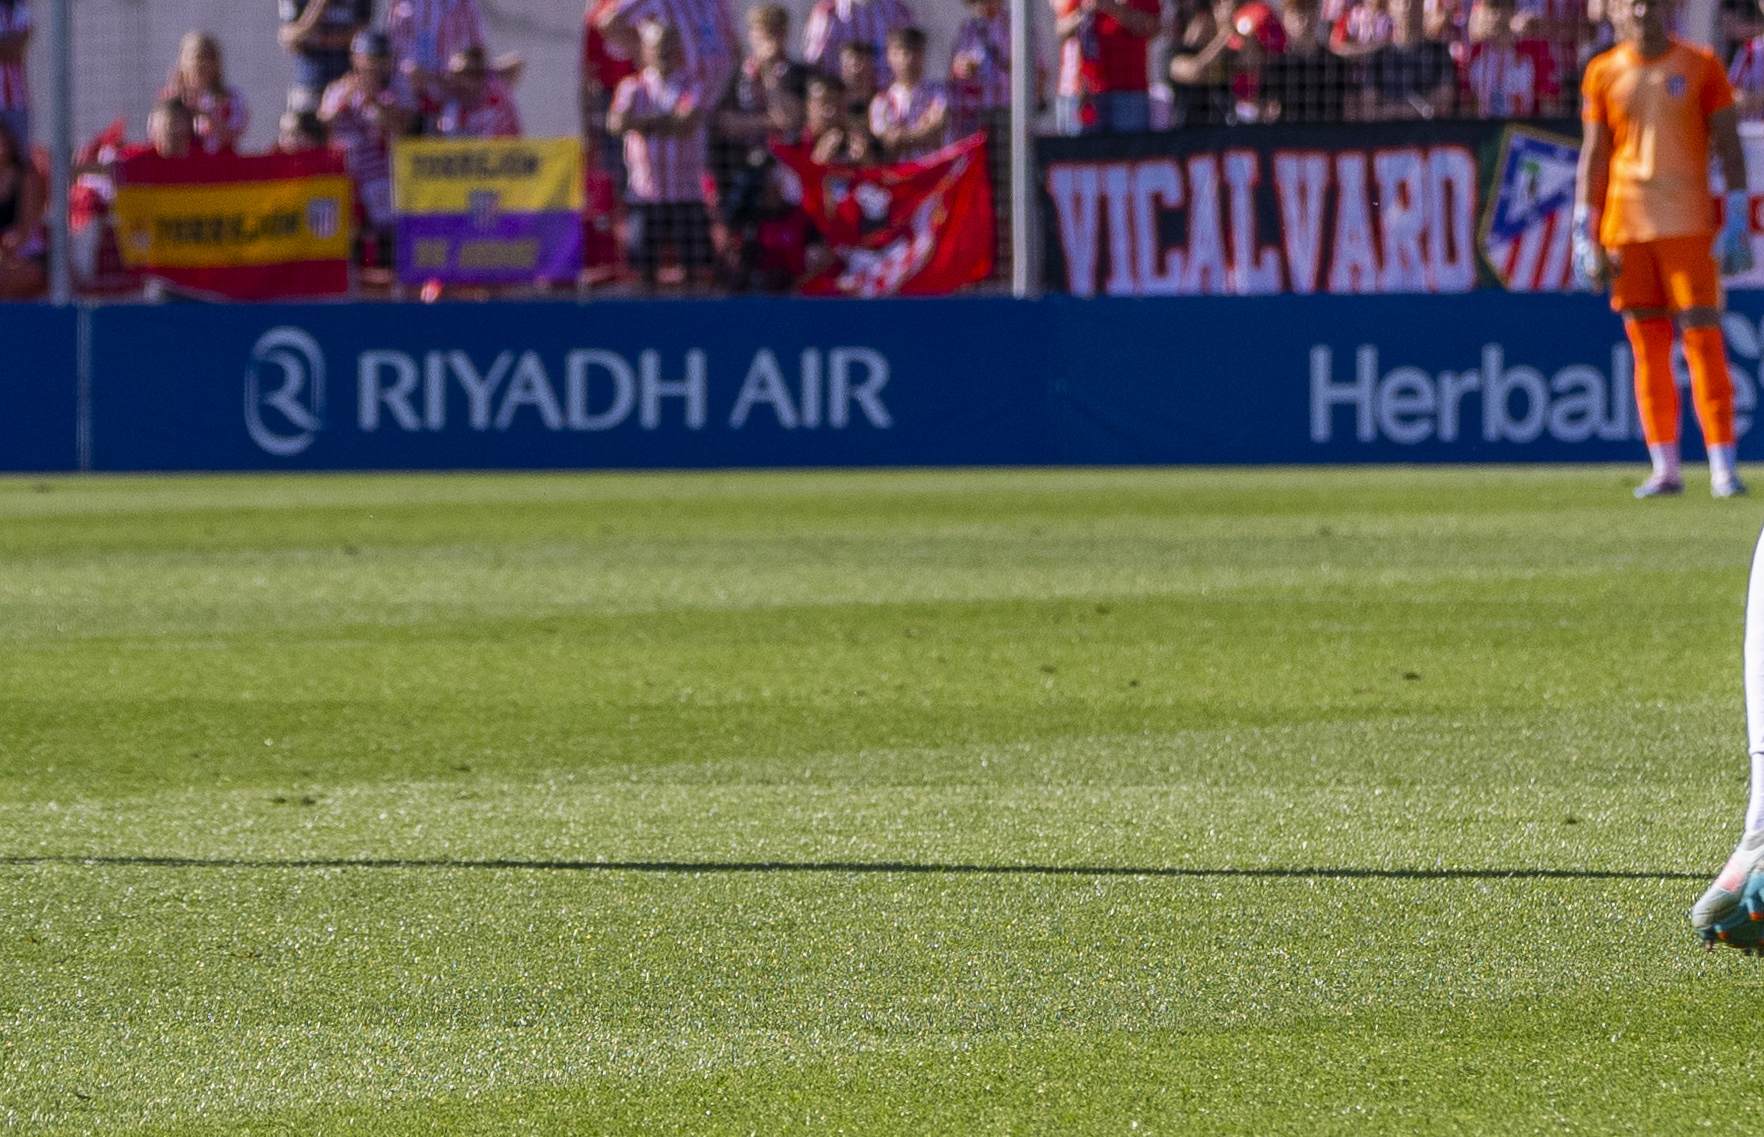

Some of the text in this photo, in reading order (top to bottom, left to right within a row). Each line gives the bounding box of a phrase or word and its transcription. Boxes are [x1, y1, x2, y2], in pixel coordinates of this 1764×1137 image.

[356, 346, 893, 432] RIYADH AIR
[1308, 342, 1757, 445] Herbal
